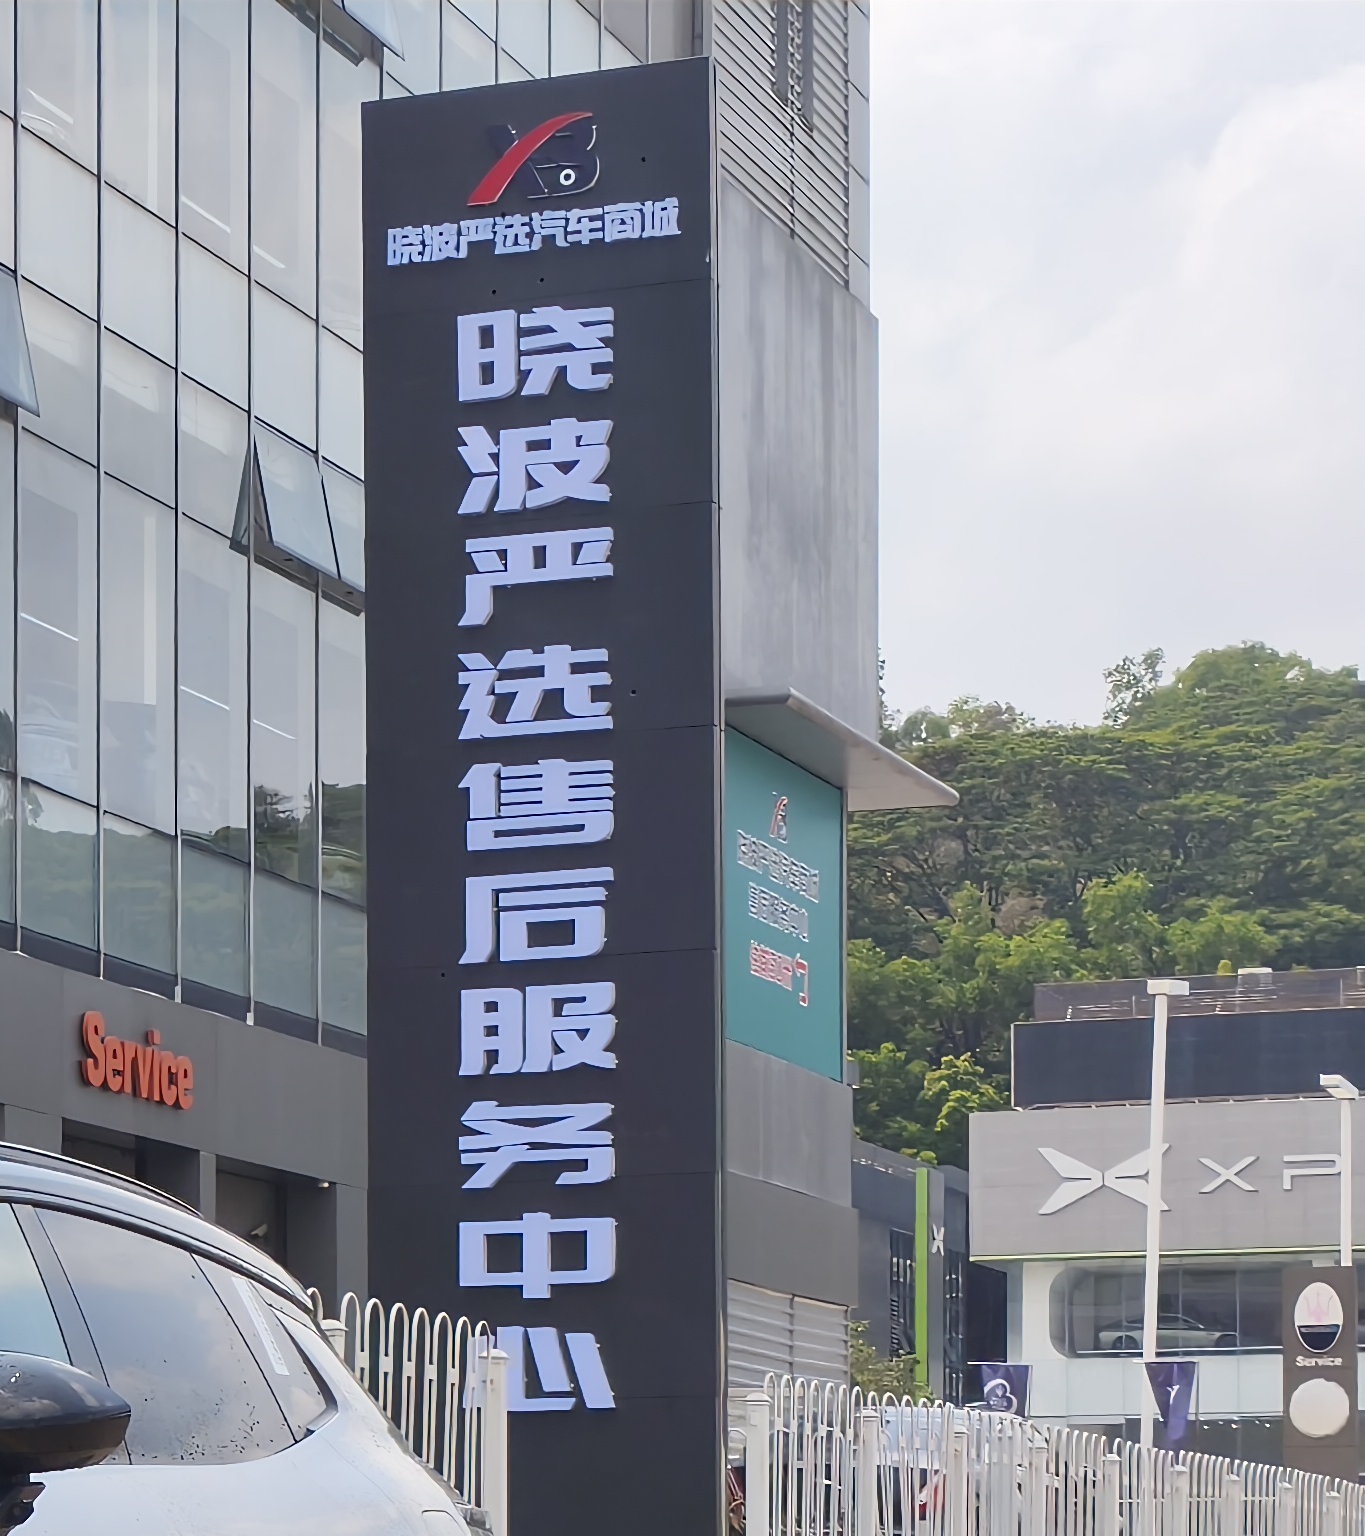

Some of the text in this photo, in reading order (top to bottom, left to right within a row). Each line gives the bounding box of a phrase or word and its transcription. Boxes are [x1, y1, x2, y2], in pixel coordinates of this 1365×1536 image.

[386, 197, 682, 266] 晓波严选汽车商城
[456, 305, 618, 1411] 晓波严选售后服务中心
[80, 1010, 194, 1111] Service
